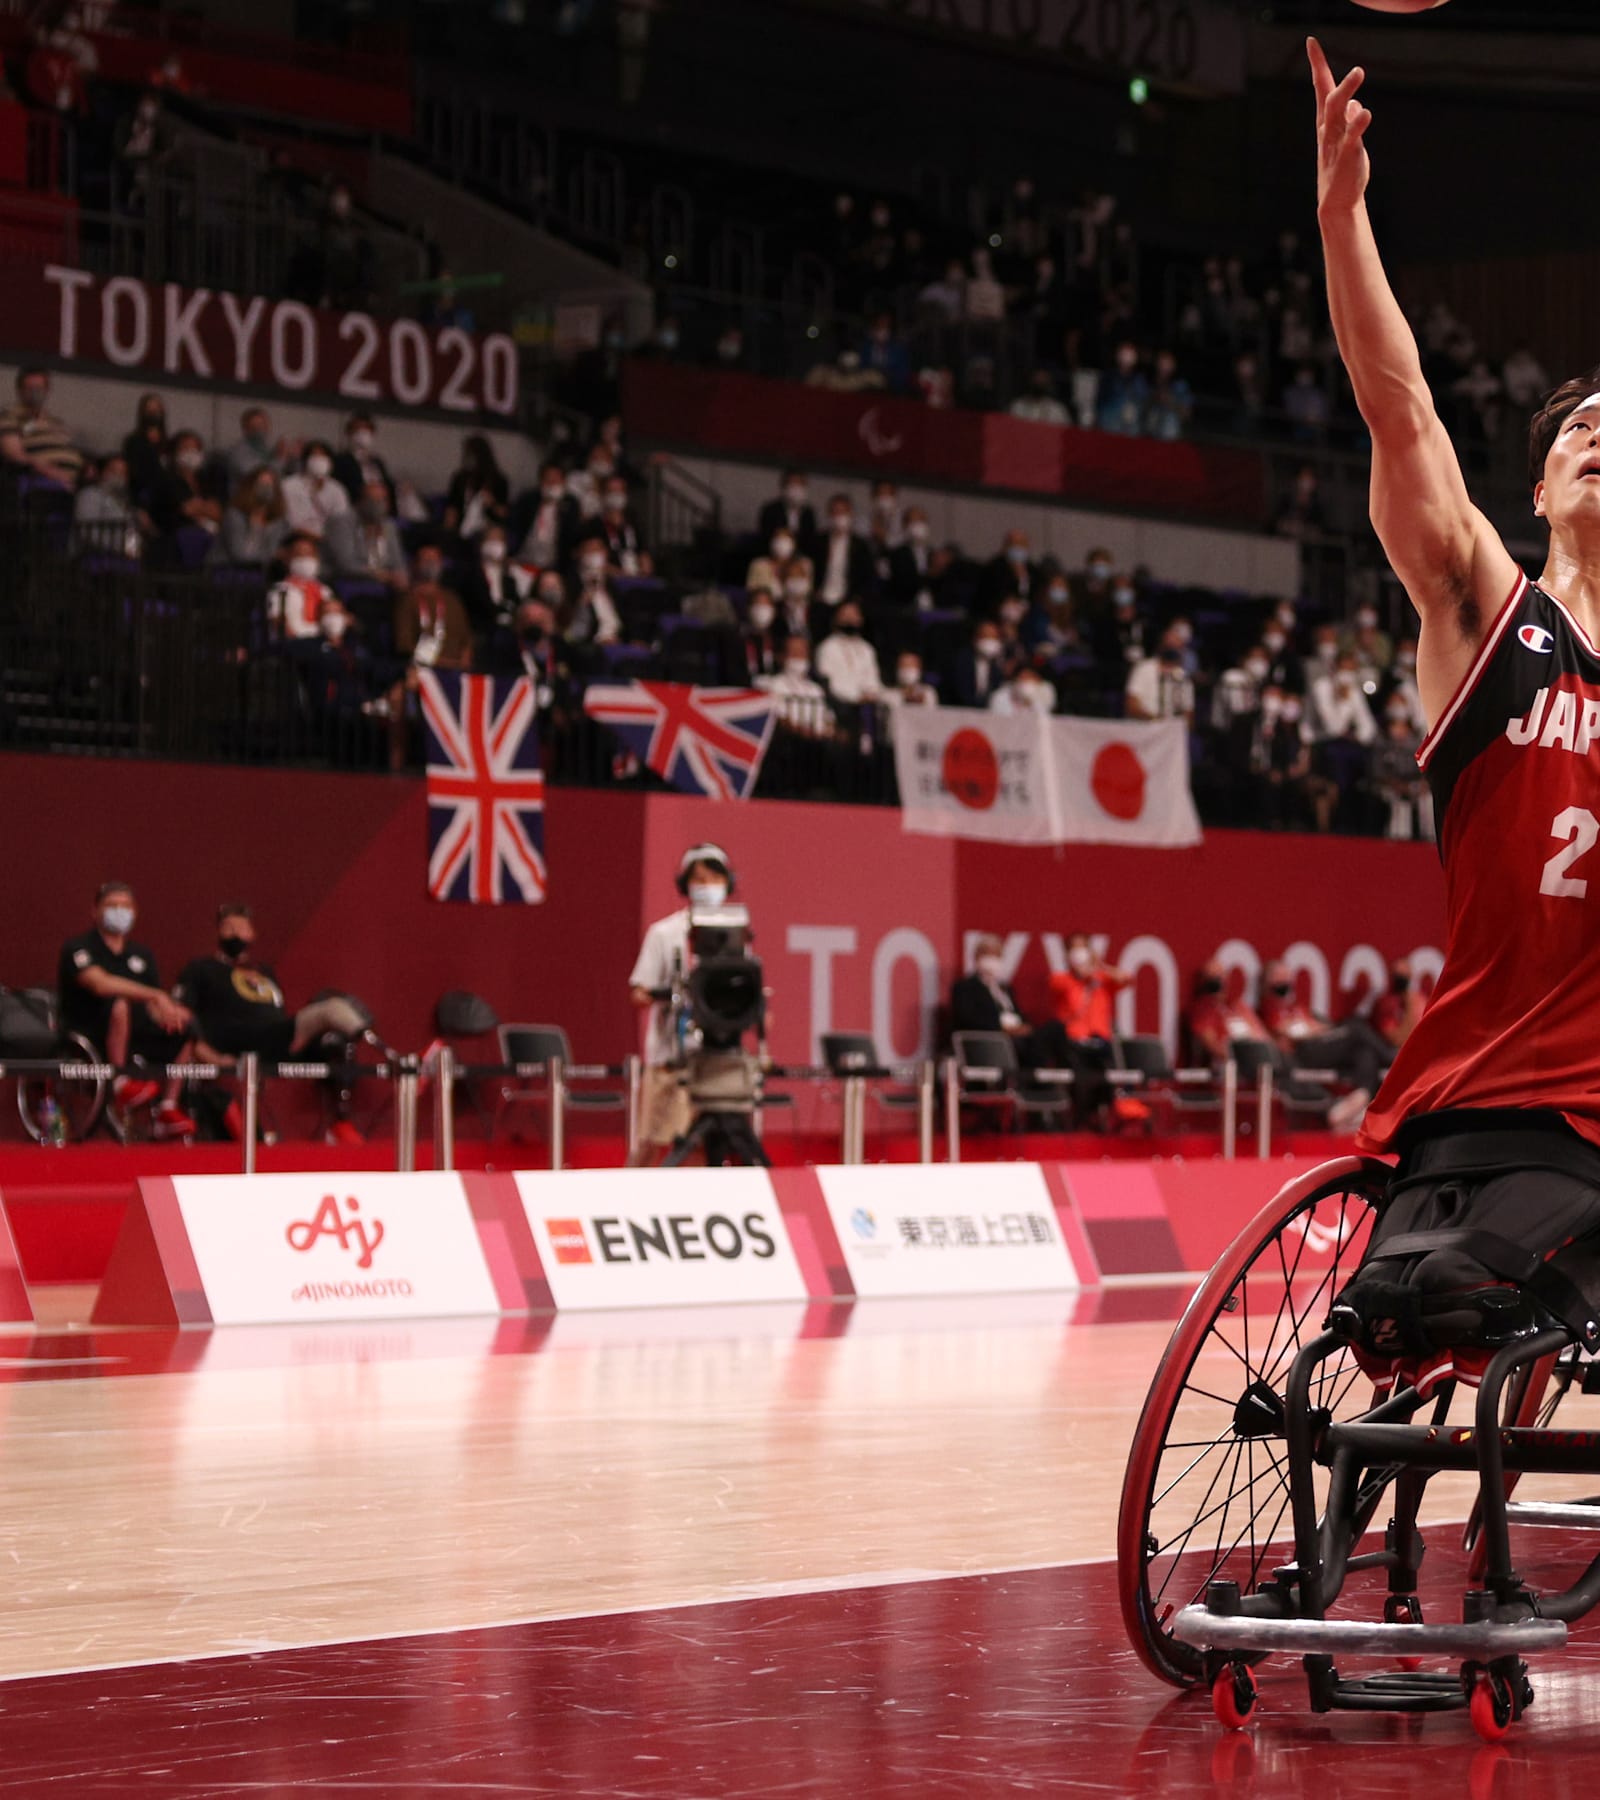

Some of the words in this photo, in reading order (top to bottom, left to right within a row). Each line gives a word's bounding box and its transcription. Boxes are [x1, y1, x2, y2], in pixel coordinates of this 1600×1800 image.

[43, 264, 316, 389] TOKYO
[338, 311, 519, 416] 2020
[1539, 805, 1600, 899] 2
[786, 925, 1180, 1070] TOO
[592, 1212, 776, 1264] ENEOS
[896, 1211, 1057, 1249] 東京海上日動
[291, 1281, 414, 1302] AJINOMOTO
